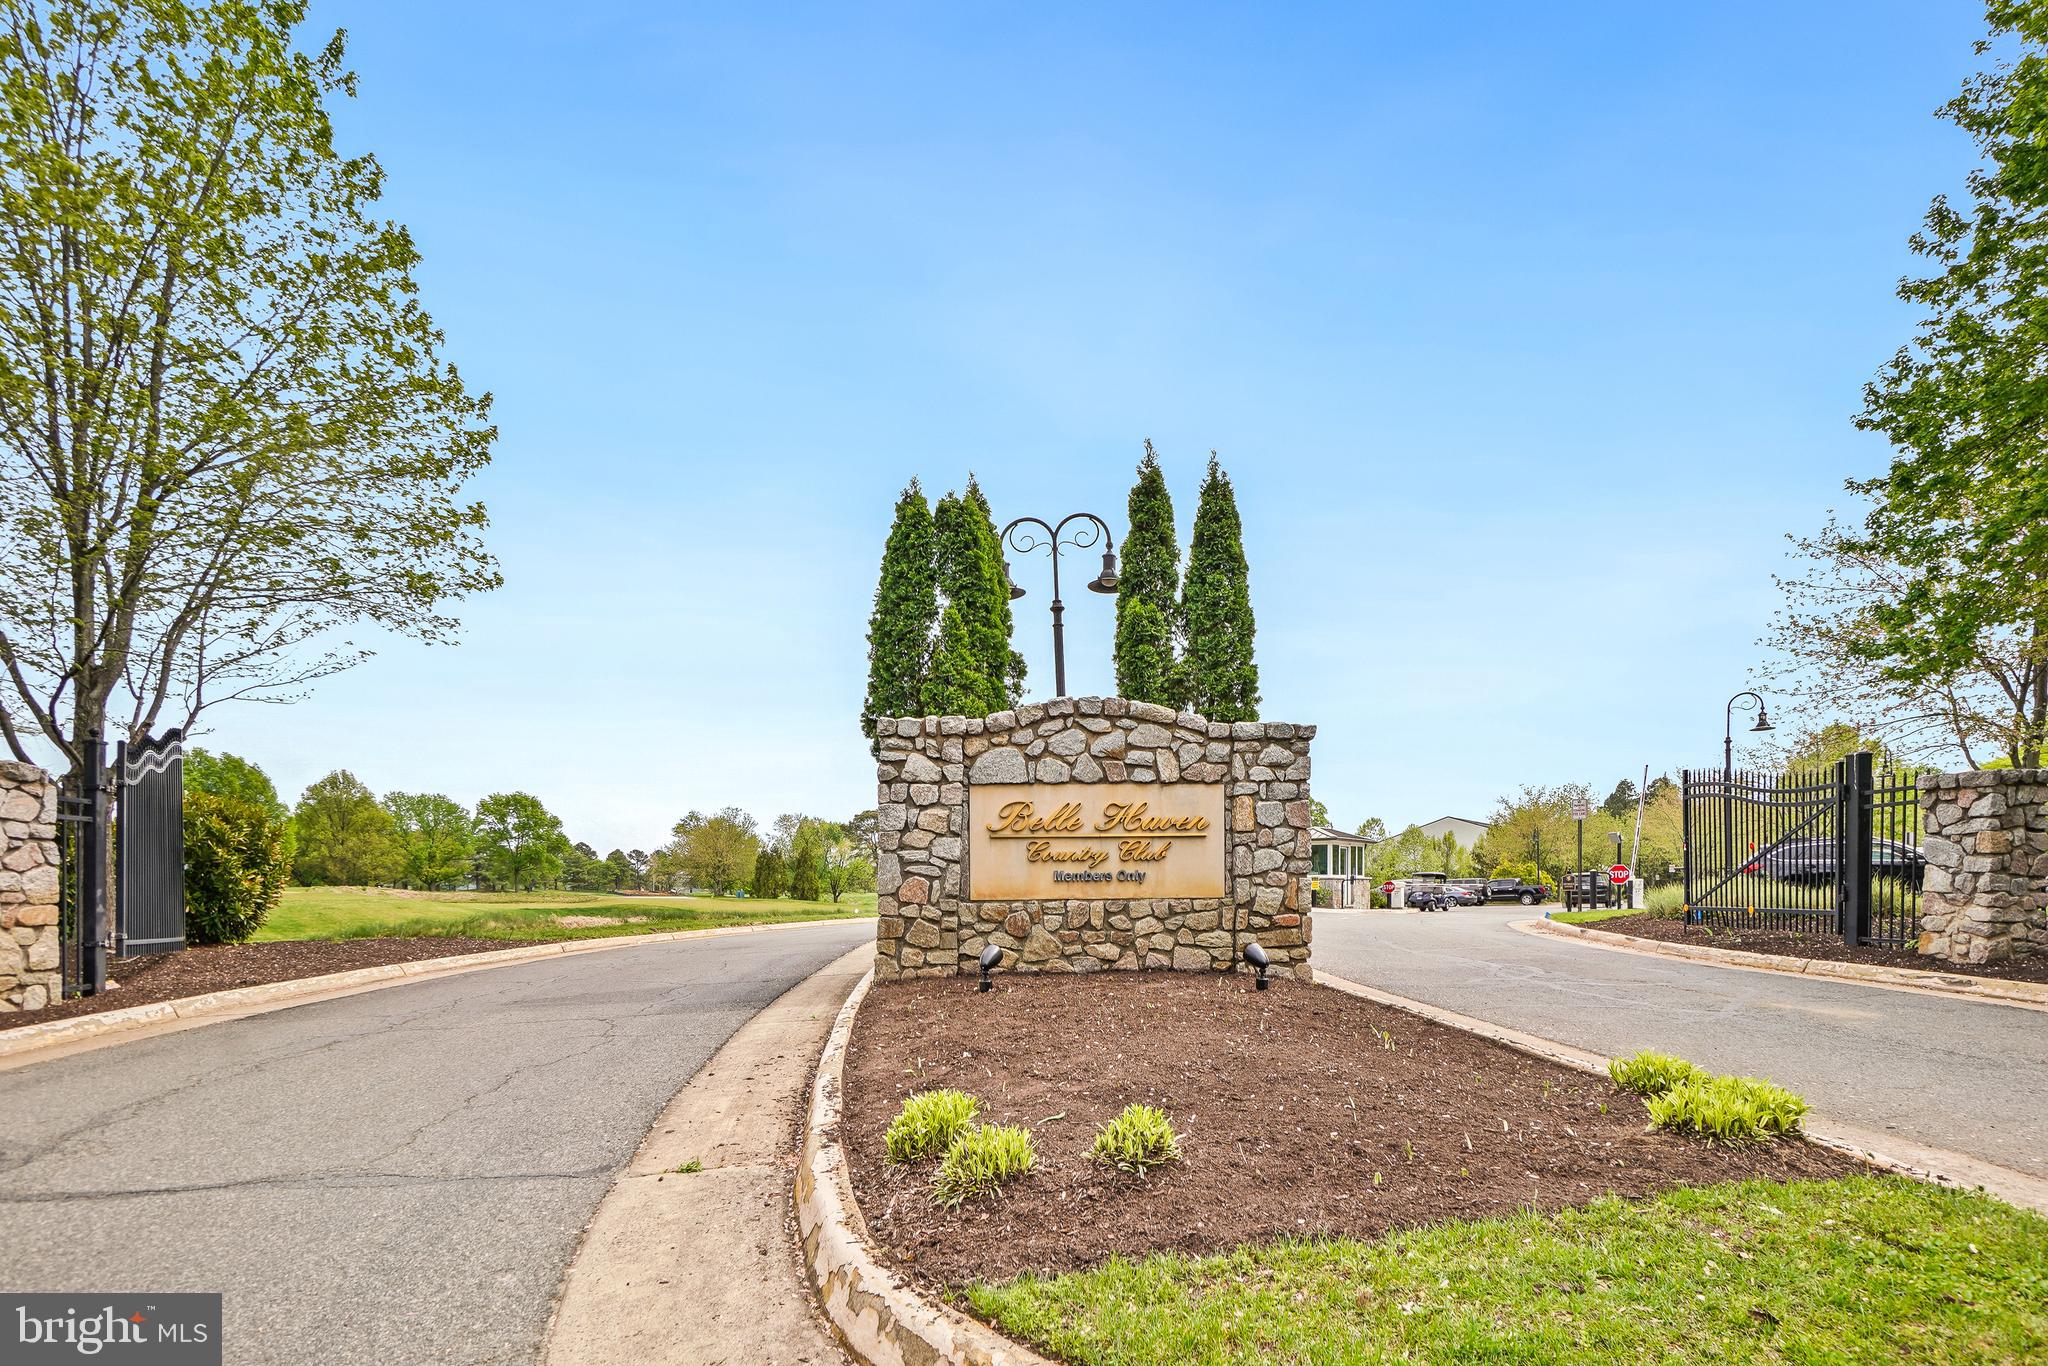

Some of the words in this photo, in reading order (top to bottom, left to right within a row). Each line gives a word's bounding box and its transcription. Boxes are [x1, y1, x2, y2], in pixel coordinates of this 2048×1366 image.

[986, 801, 1084, 832] Belle
[1094, 801, 1210, 832] Haven
[1026, 841, 1109, 868] Country
[1118, 841, 1171, 862] Club
[1053, 870, 1113, 883] Members
[1116, 870, 1146, 884] Only
[1609, 870, 1629, 879] STOP
